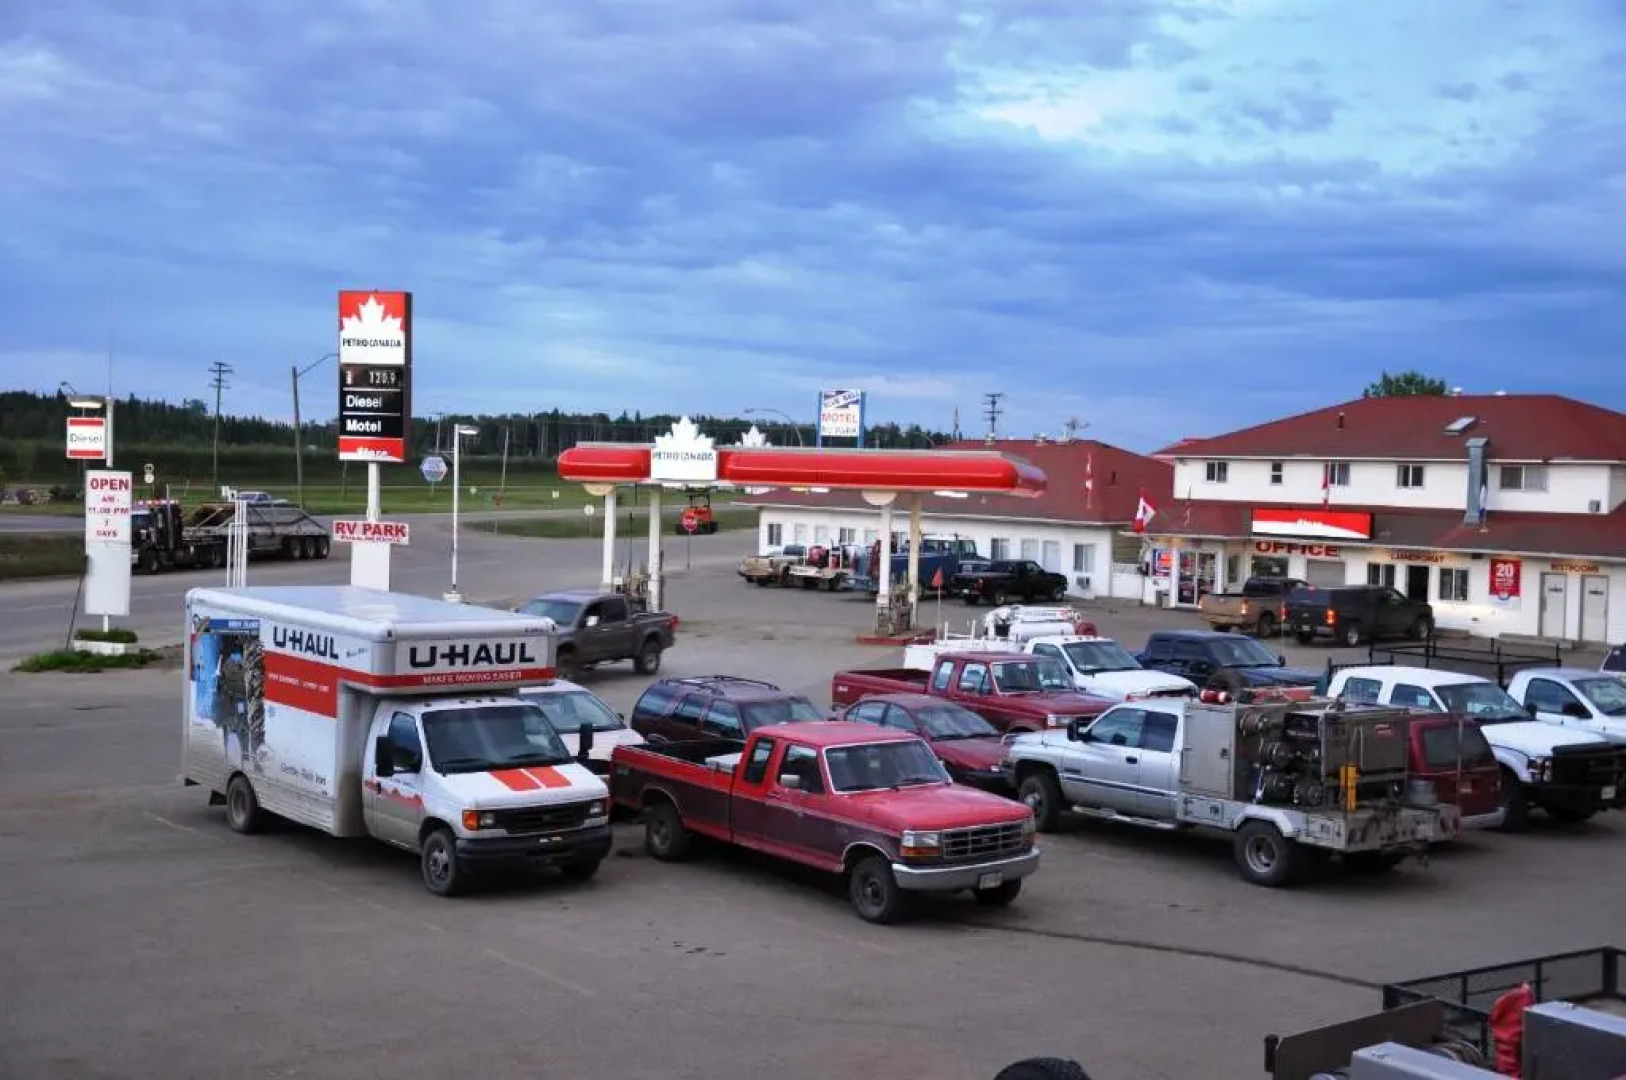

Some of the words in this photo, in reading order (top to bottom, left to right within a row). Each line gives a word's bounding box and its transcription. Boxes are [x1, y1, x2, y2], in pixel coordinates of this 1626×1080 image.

[345, 395, 382, 407] Diesel
[822, 413, 857, 423] MOTEL
[345, 419, 382, 433] Motel
[69, 433, 102, 443] Diesel
[90, 478, 129, 490] OPEN
[335, 522, 357, 535] RV
[362, 523, 406, 537] PARK
[1256, 541, 1338, 557] OFFICE
[1496, 563, 1514, 577] 20
[273, 626, 339, 660] U-HAUL
[409, 642, 536, 668] U-HAUL
[422, 674, 453, 684] MAKES
[455, 673, 491, 682] MOVING
[493, 671, 522, 681] EASIER
